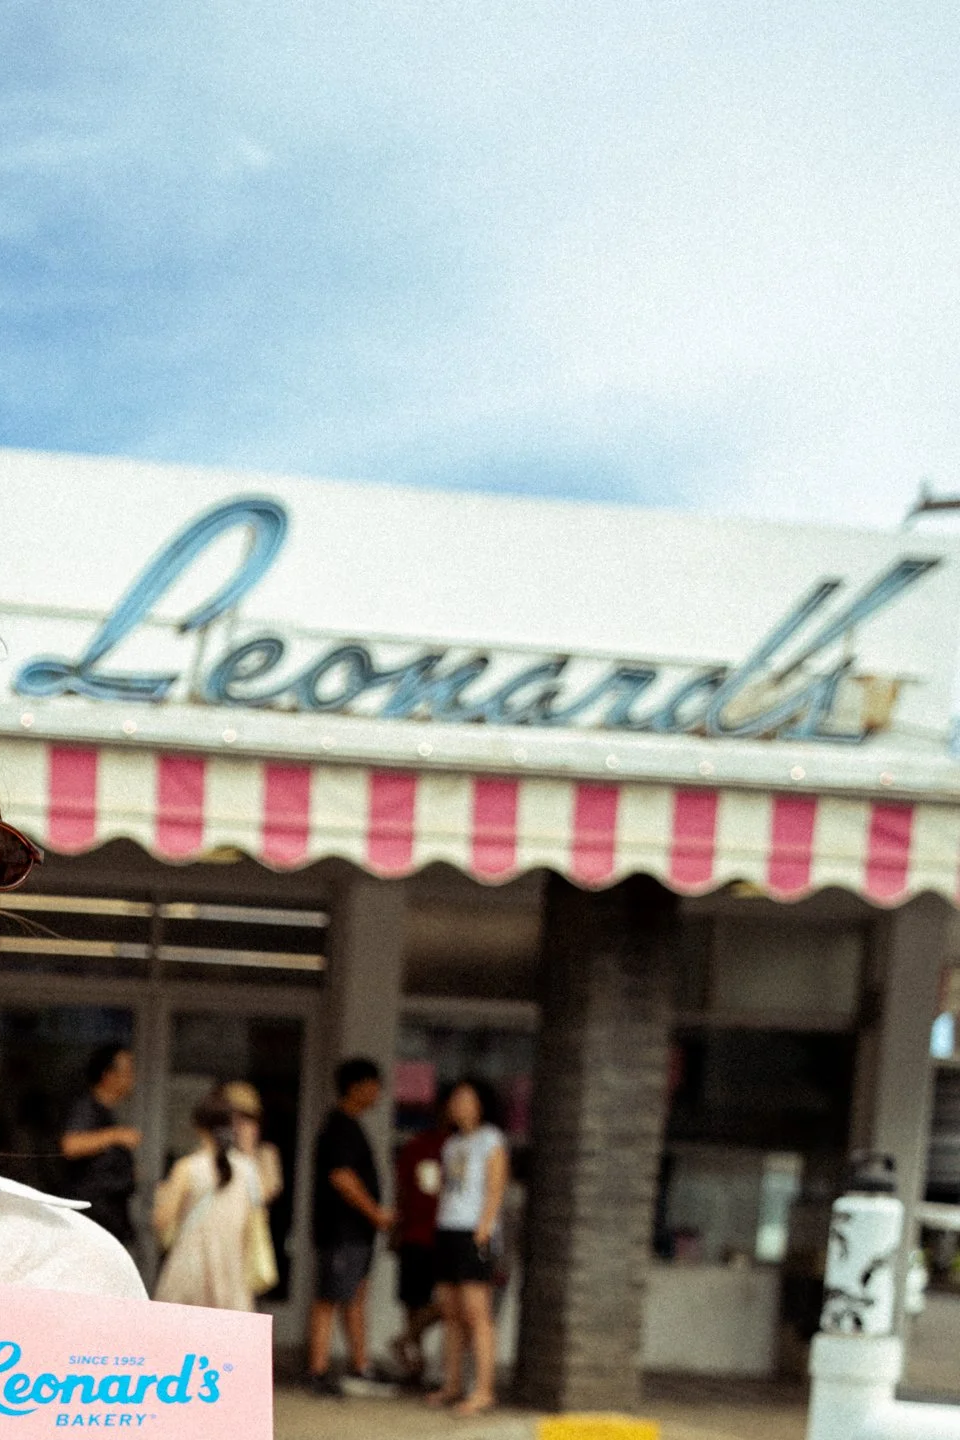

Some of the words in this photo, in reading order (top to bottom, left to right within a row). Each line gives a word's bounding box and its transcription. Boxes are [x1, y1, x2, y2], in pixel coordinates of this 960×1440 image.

[14, 497, 942, 746] Leonard's
[68, 1355, 109, 1365] SINCE
[114, 1356, 146, 1366] 1952
[55, 1413, 148, 1427] BAKERY
